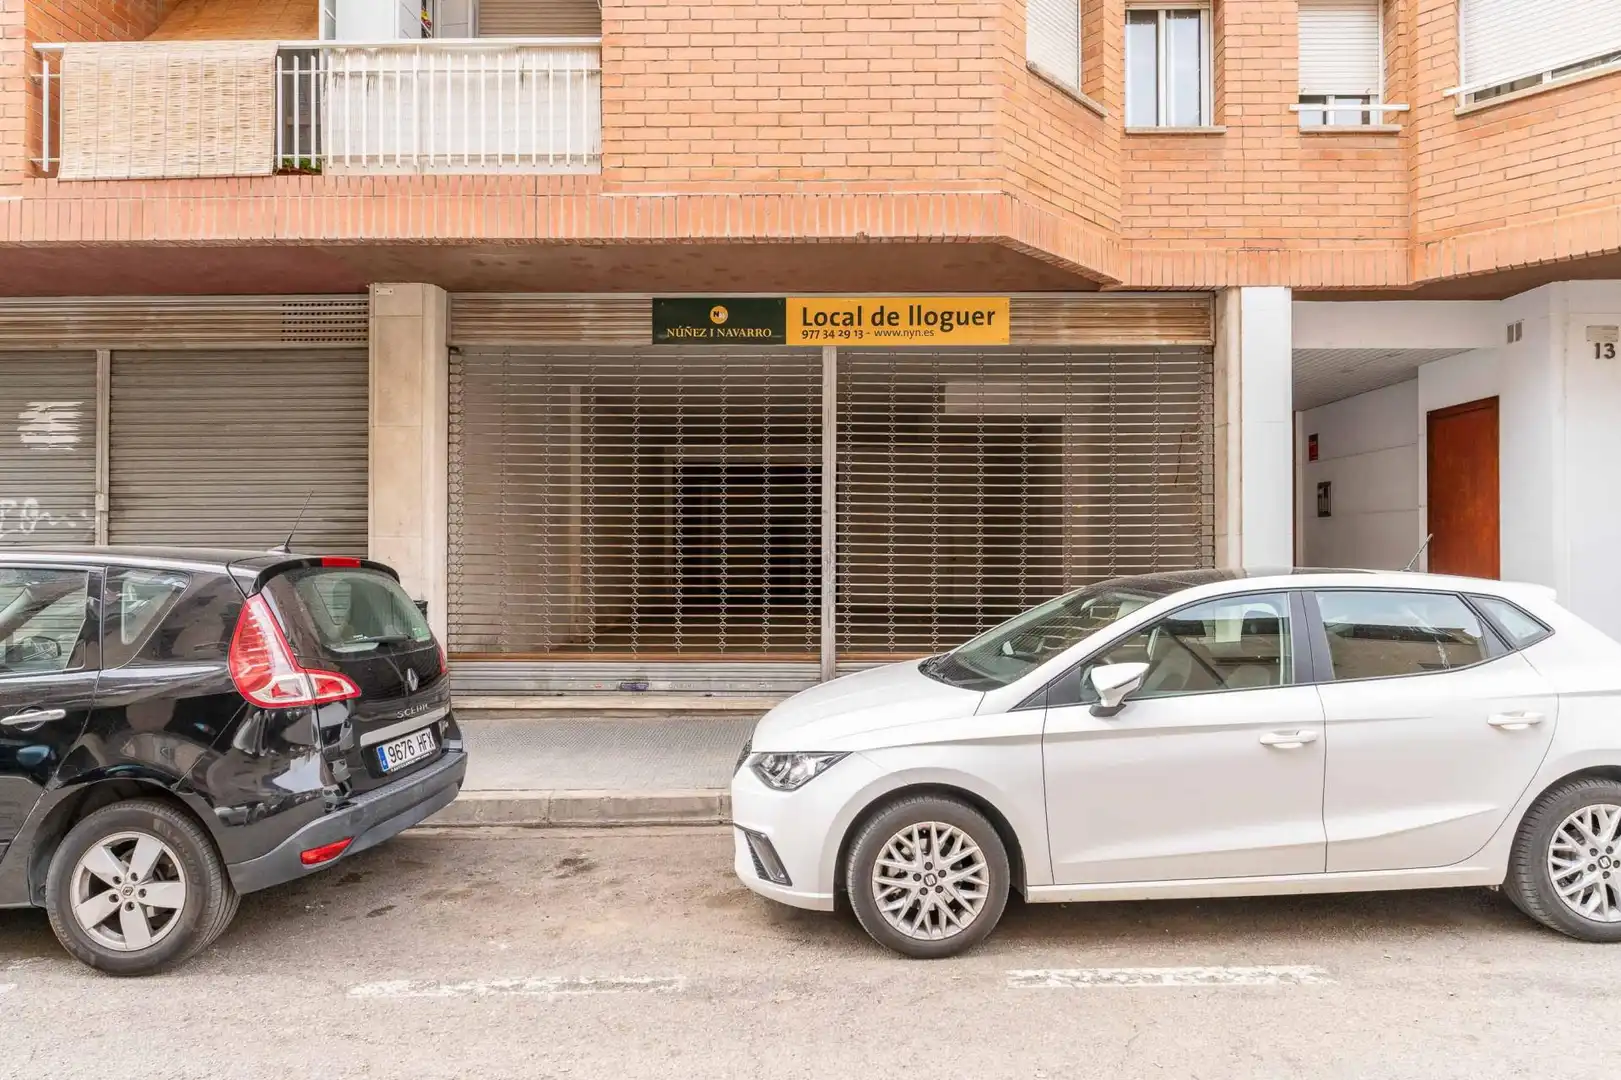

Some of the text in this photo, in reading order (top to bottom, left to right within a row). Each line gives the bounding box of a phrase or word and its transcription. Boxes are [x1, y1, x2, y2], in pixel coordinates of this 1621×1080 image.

[802, 305, 995, 332] Local de lloguer
[667, 325, 772, 338] NÚÑEZ I NAVARRO
[802, 329, 820, 339] 977
[823, 329, 835, 339] 34
[838, 329, 851, 339] 29
[854, 329, 864, 339] 13
[874, 328, 935, 338] www.nyn.es
[1594, 342, 1616, 359] 13
[388, 739, 415, 764] 9676
[416, 731, 436, 752] HFX
